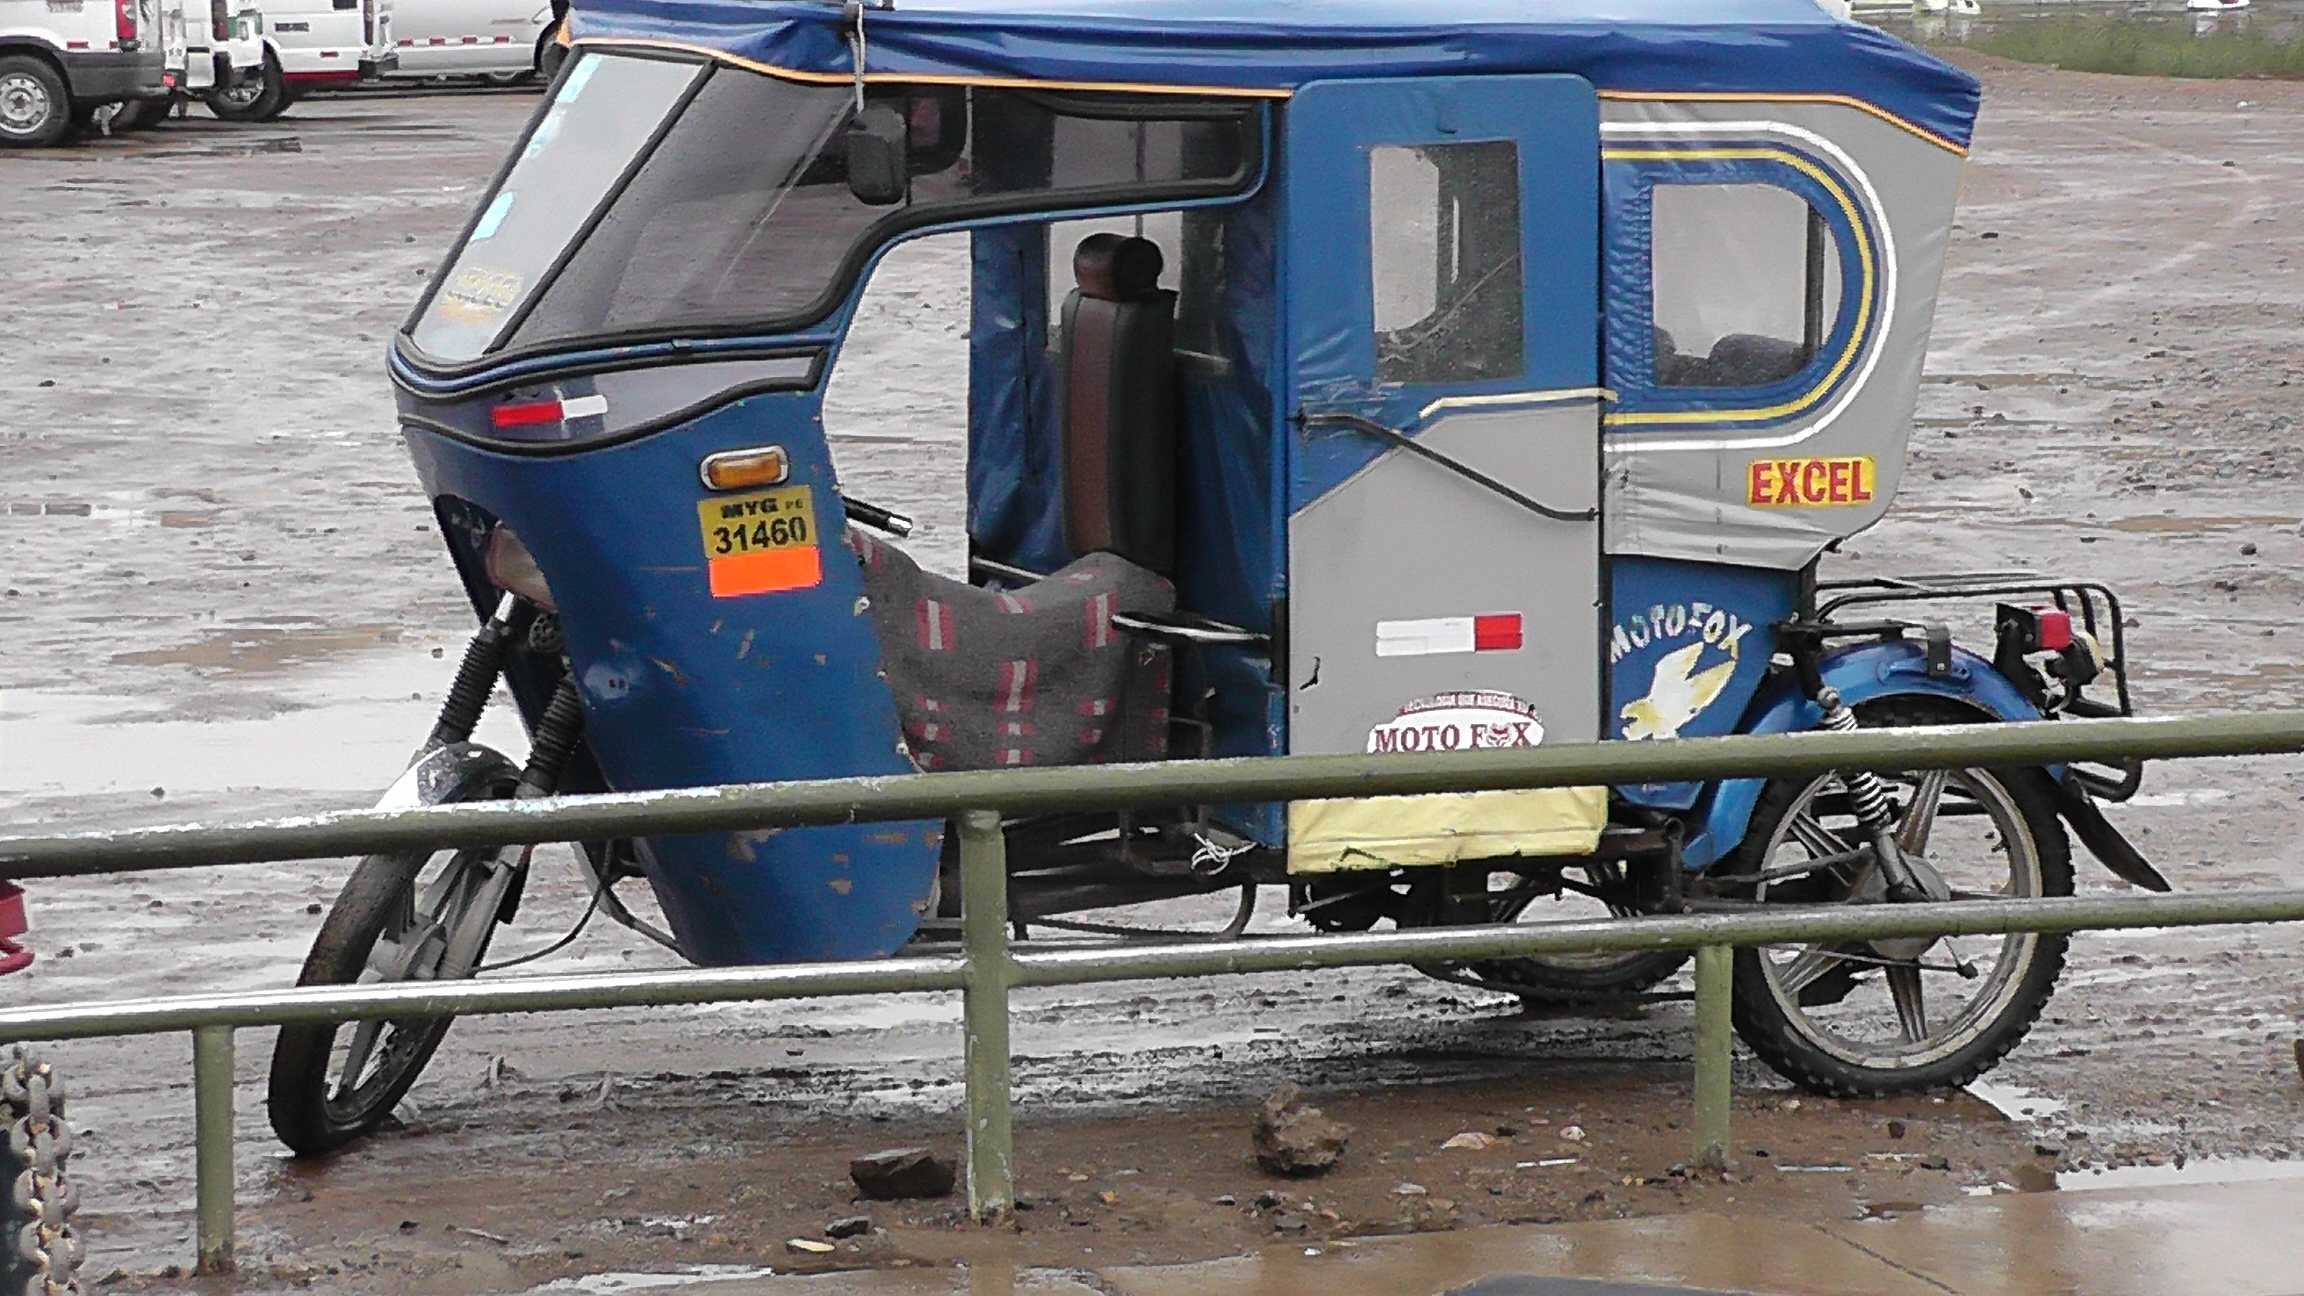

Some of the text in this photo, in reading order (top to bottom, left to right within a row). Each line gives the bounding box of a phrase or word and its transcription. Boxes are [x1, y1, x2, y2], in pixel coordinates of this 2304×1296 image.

[1751, 460, 1871, 503] EXCEL
[713, 516, 807, 554] 31460
[1374, 724, 1461, 753] MOTO
